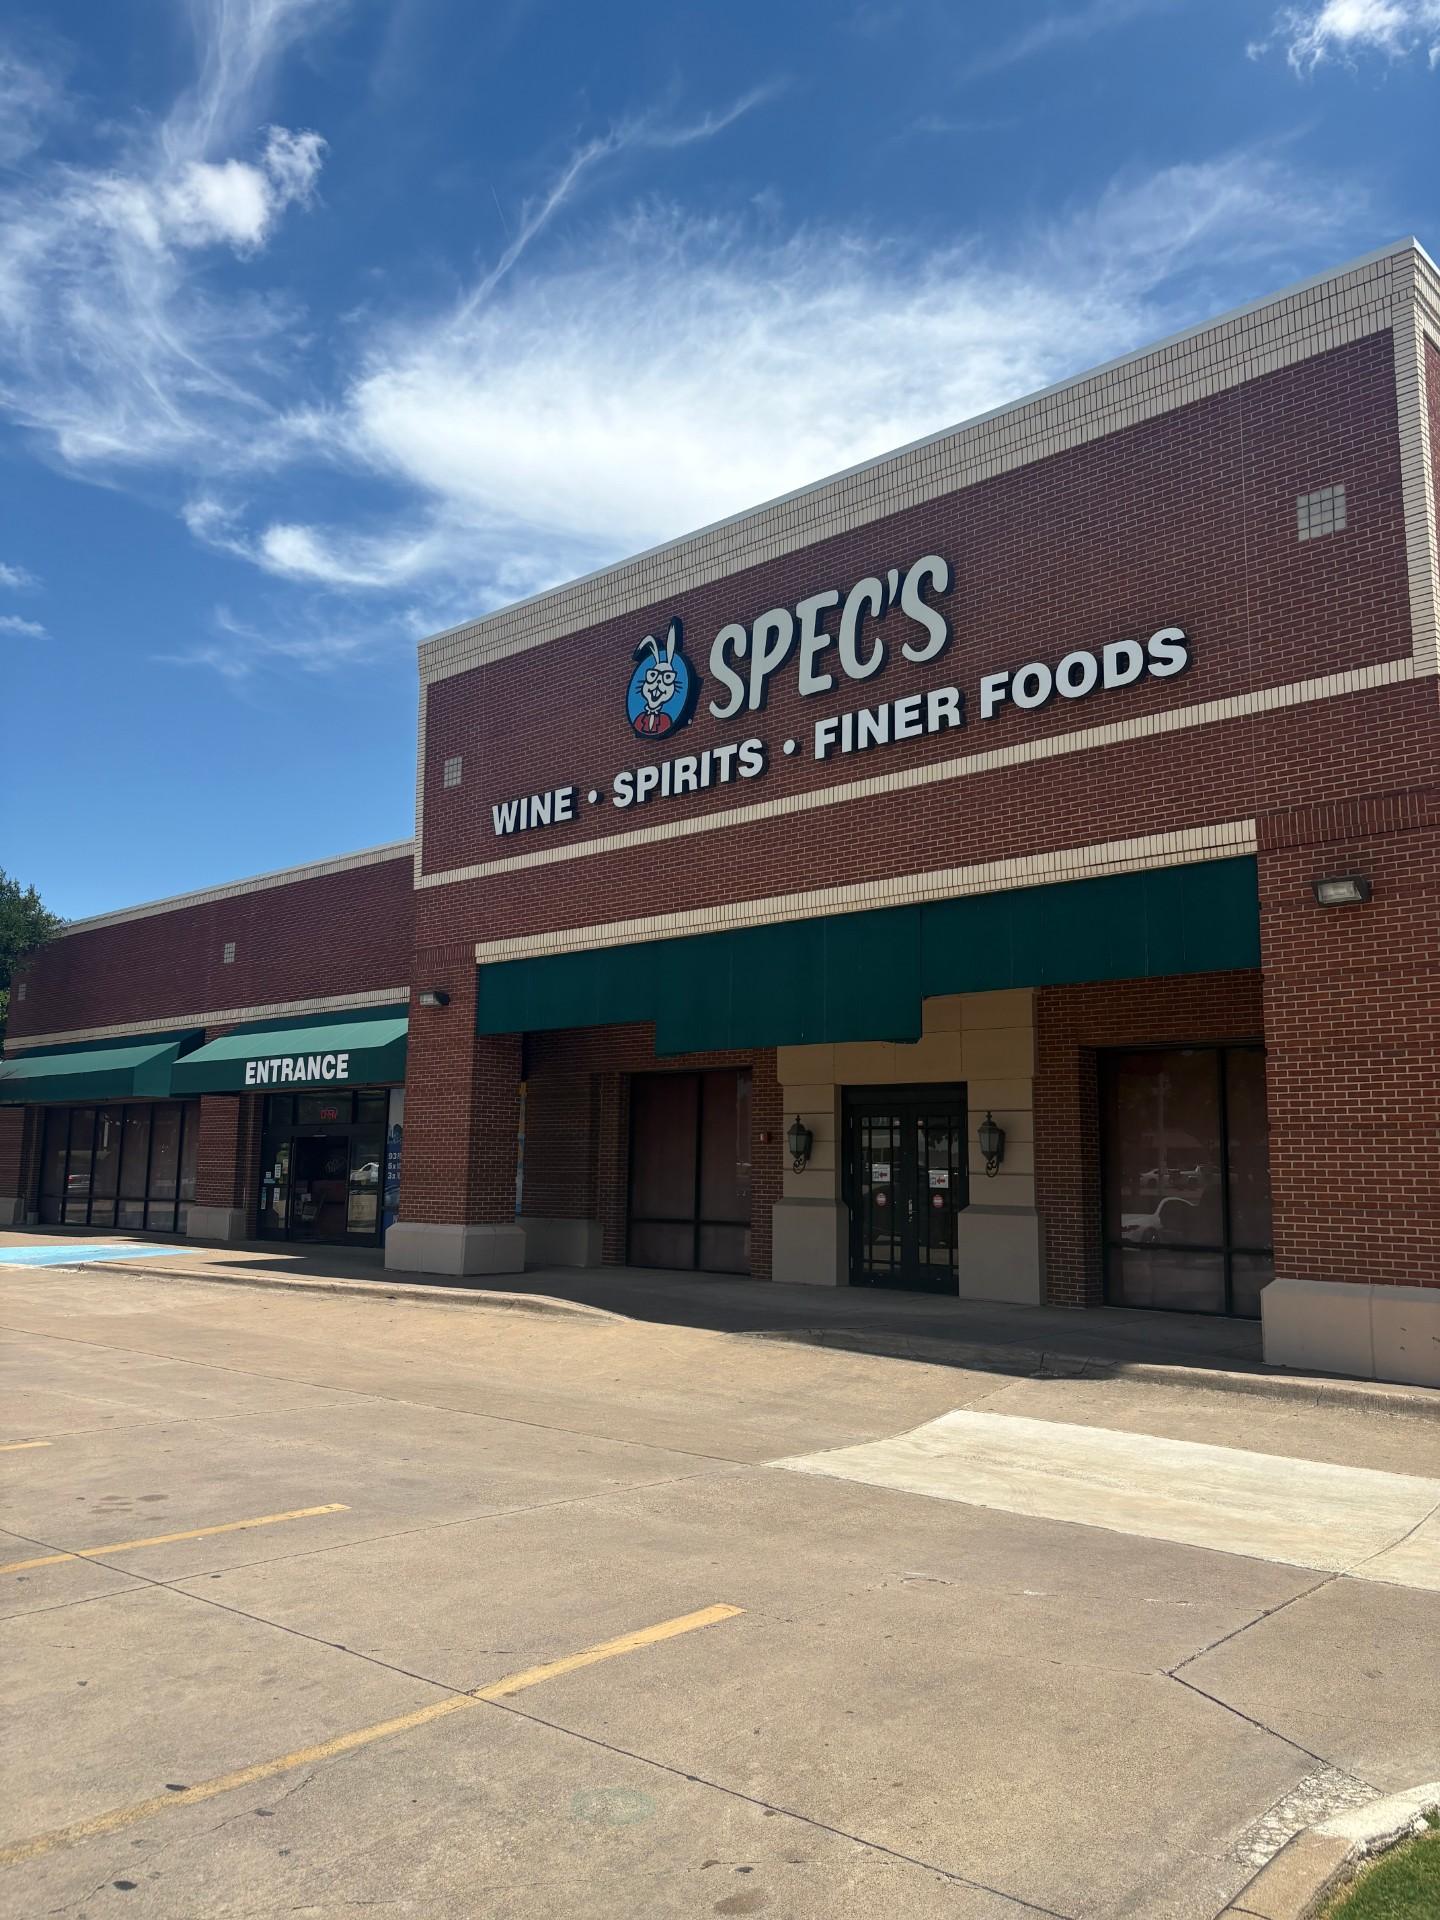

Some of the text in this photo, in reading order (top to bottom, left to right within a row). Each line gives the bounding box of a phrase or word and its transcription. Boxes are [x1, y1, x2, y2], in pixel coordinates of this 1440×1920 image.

[709, 555, 949, 720] SPEC'S
[491, 627, 1189, 836] WINE SPIRITS FINER FOODS
[245, 1053, 349, 1085] ENTRANCE
